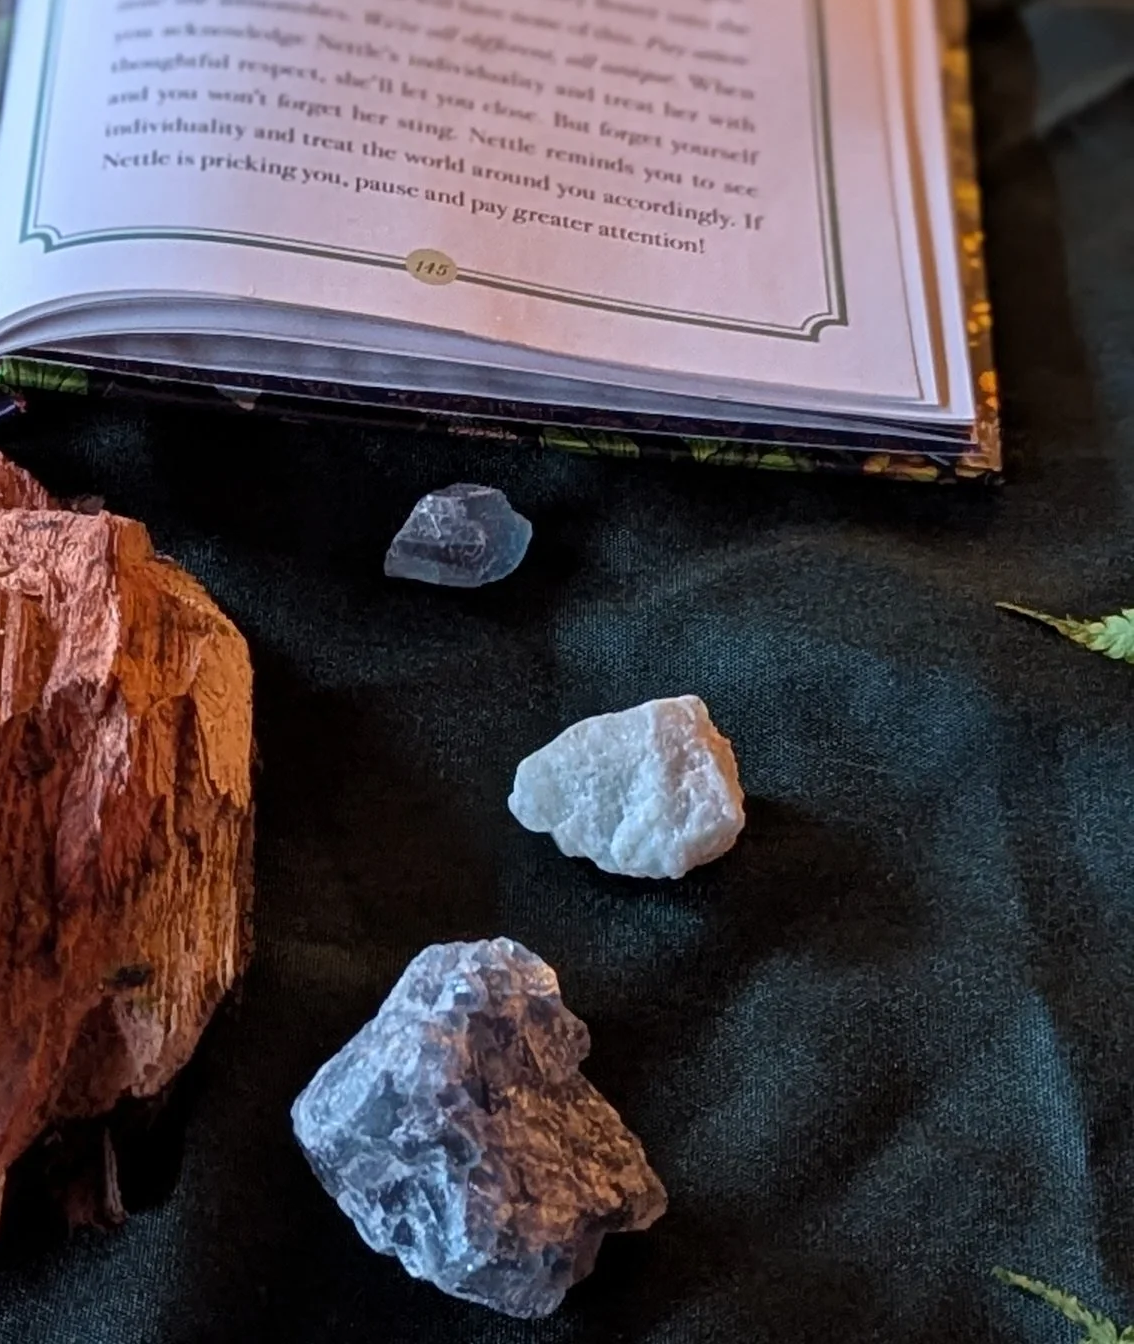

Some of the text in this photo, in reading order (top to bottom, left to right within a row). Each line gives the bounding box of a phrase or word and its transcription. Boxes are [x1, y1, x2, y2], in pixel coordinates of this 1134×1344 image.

[110, 53, 229, 74] thoughtful
[238, 59, 325, 84] respect,
[335, 71, 392, 95] she'll
[401, 81, 426, 101] let
[436, 93, 474, 111] you
[553, 110, 589, 134] But
[600, 121, 661, 148] forget
[670, 139, 760, 166] yourself
[113, 22, 755, 134] you acknowledge Nettle's individuality and treat her with
[104, 116, 764, 231] individuality and treat the world around you accordingly. If
[107, 85, 758, 199] and you won't forget her sting. Nettle reminds you to see
[102, 149, 705, 255] Nettle is pricking you, pause and pay greater attention!
[415, 260, 450, 277] 145
